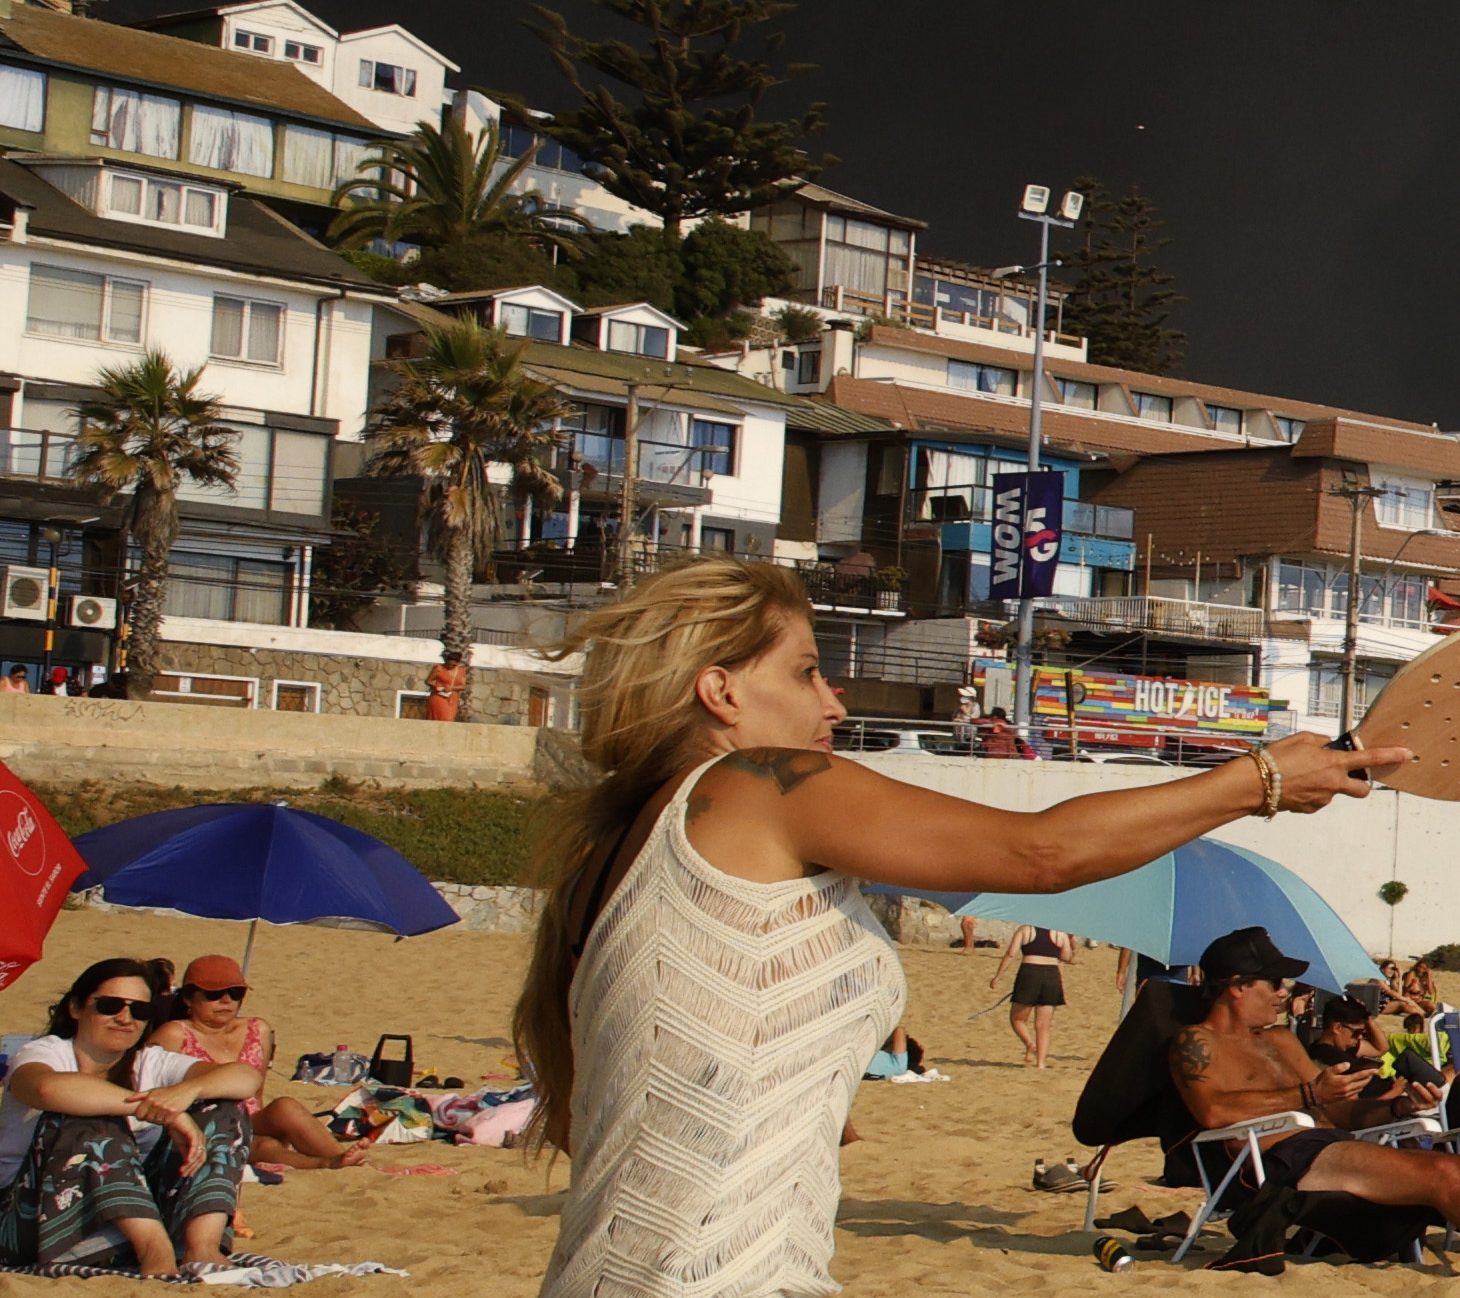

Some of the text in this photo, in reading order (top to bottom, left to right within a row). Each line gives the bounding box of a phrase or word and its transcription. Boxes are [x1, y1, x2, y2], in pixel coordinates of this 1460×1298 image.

[993, 488, 1021, 585] WOM
[1024, 507, 1058, 562] 5G
[1135, 679, 1232, 720] HOT ICE
